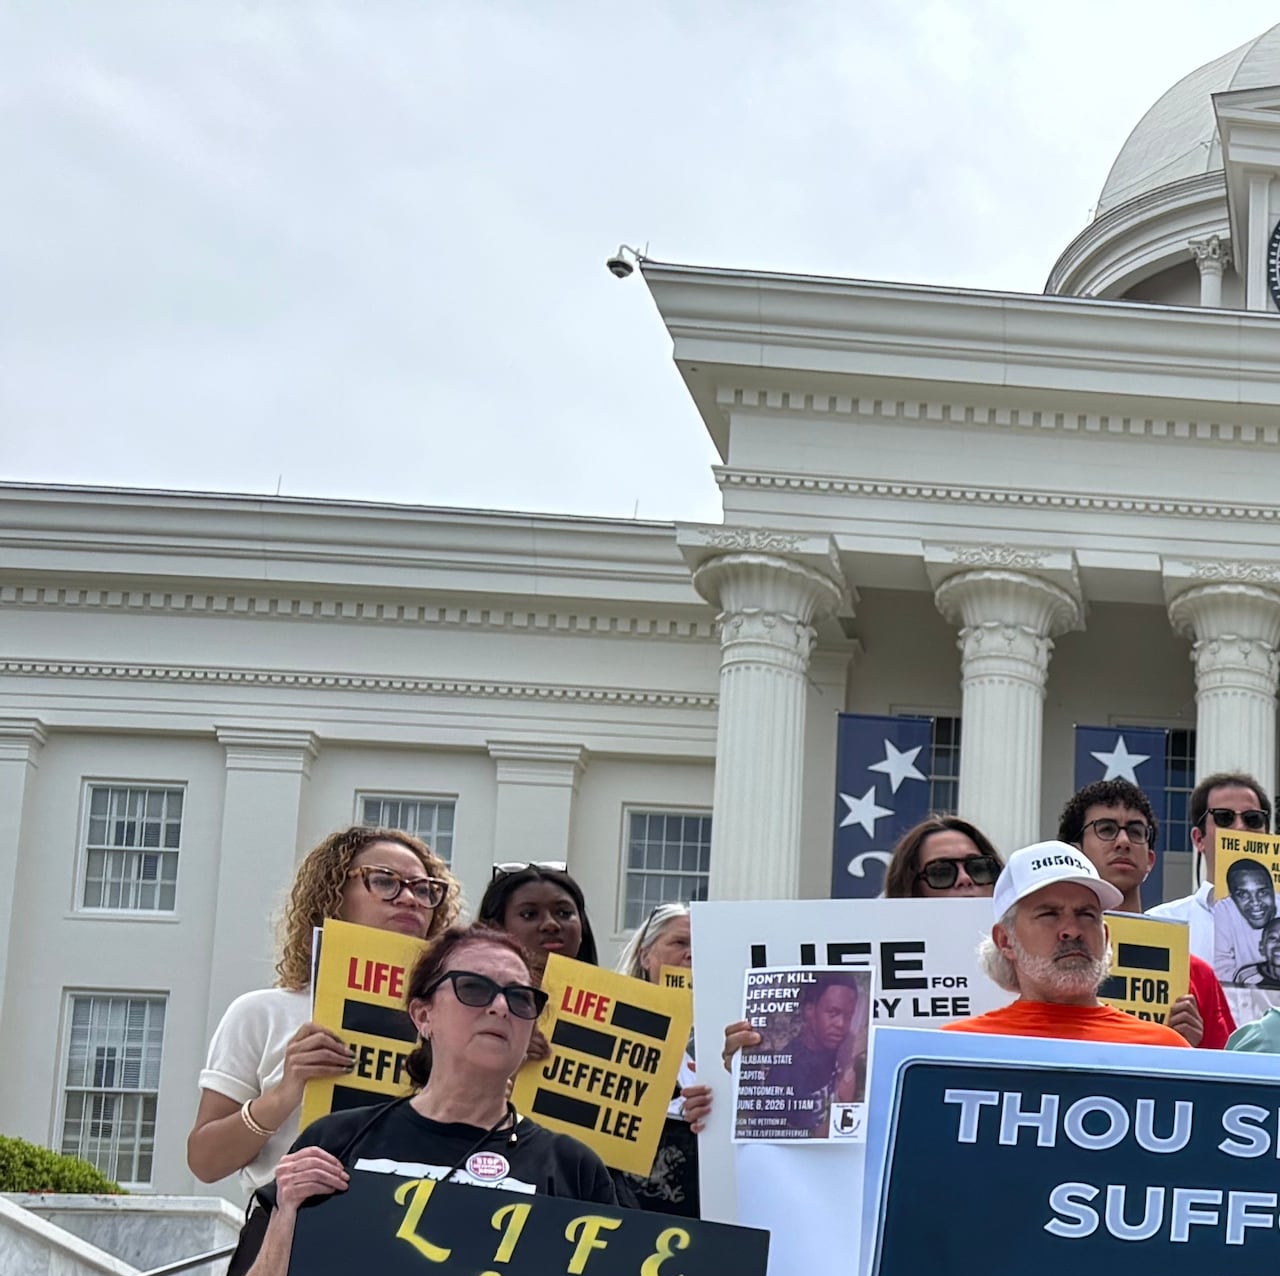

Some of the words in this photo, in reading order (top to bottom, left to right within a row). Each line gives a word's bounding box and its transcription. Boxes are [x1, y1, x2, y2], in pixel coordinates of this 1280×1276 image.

[1221, 837, 1240, 851] THE
[1243, 840, 1269, 855] JURY
[347, 956, 405, 999] LIFE
[665, 974, 685, 989] THE
[748, 973, 784, 985] DON'T
[787, 973, 817, 984] KILL
[931, 976, 968, 988] FOR
[746, 987, 800, 1000] JEFFERY
[1130, 977, 1169, 1005] FOR
[560, 985, 611, 1024] LIFE
[912, 996, 971, 1017] LEE
[615, 1038, 662, 1075] FOR
[772, 1054, 793, 1065] STATE
[542, 1055, 649, 1107] JEFFERY
[600, 1107, 643, 1143] LEE
[944, 1088, 1194, 1155] THOU
